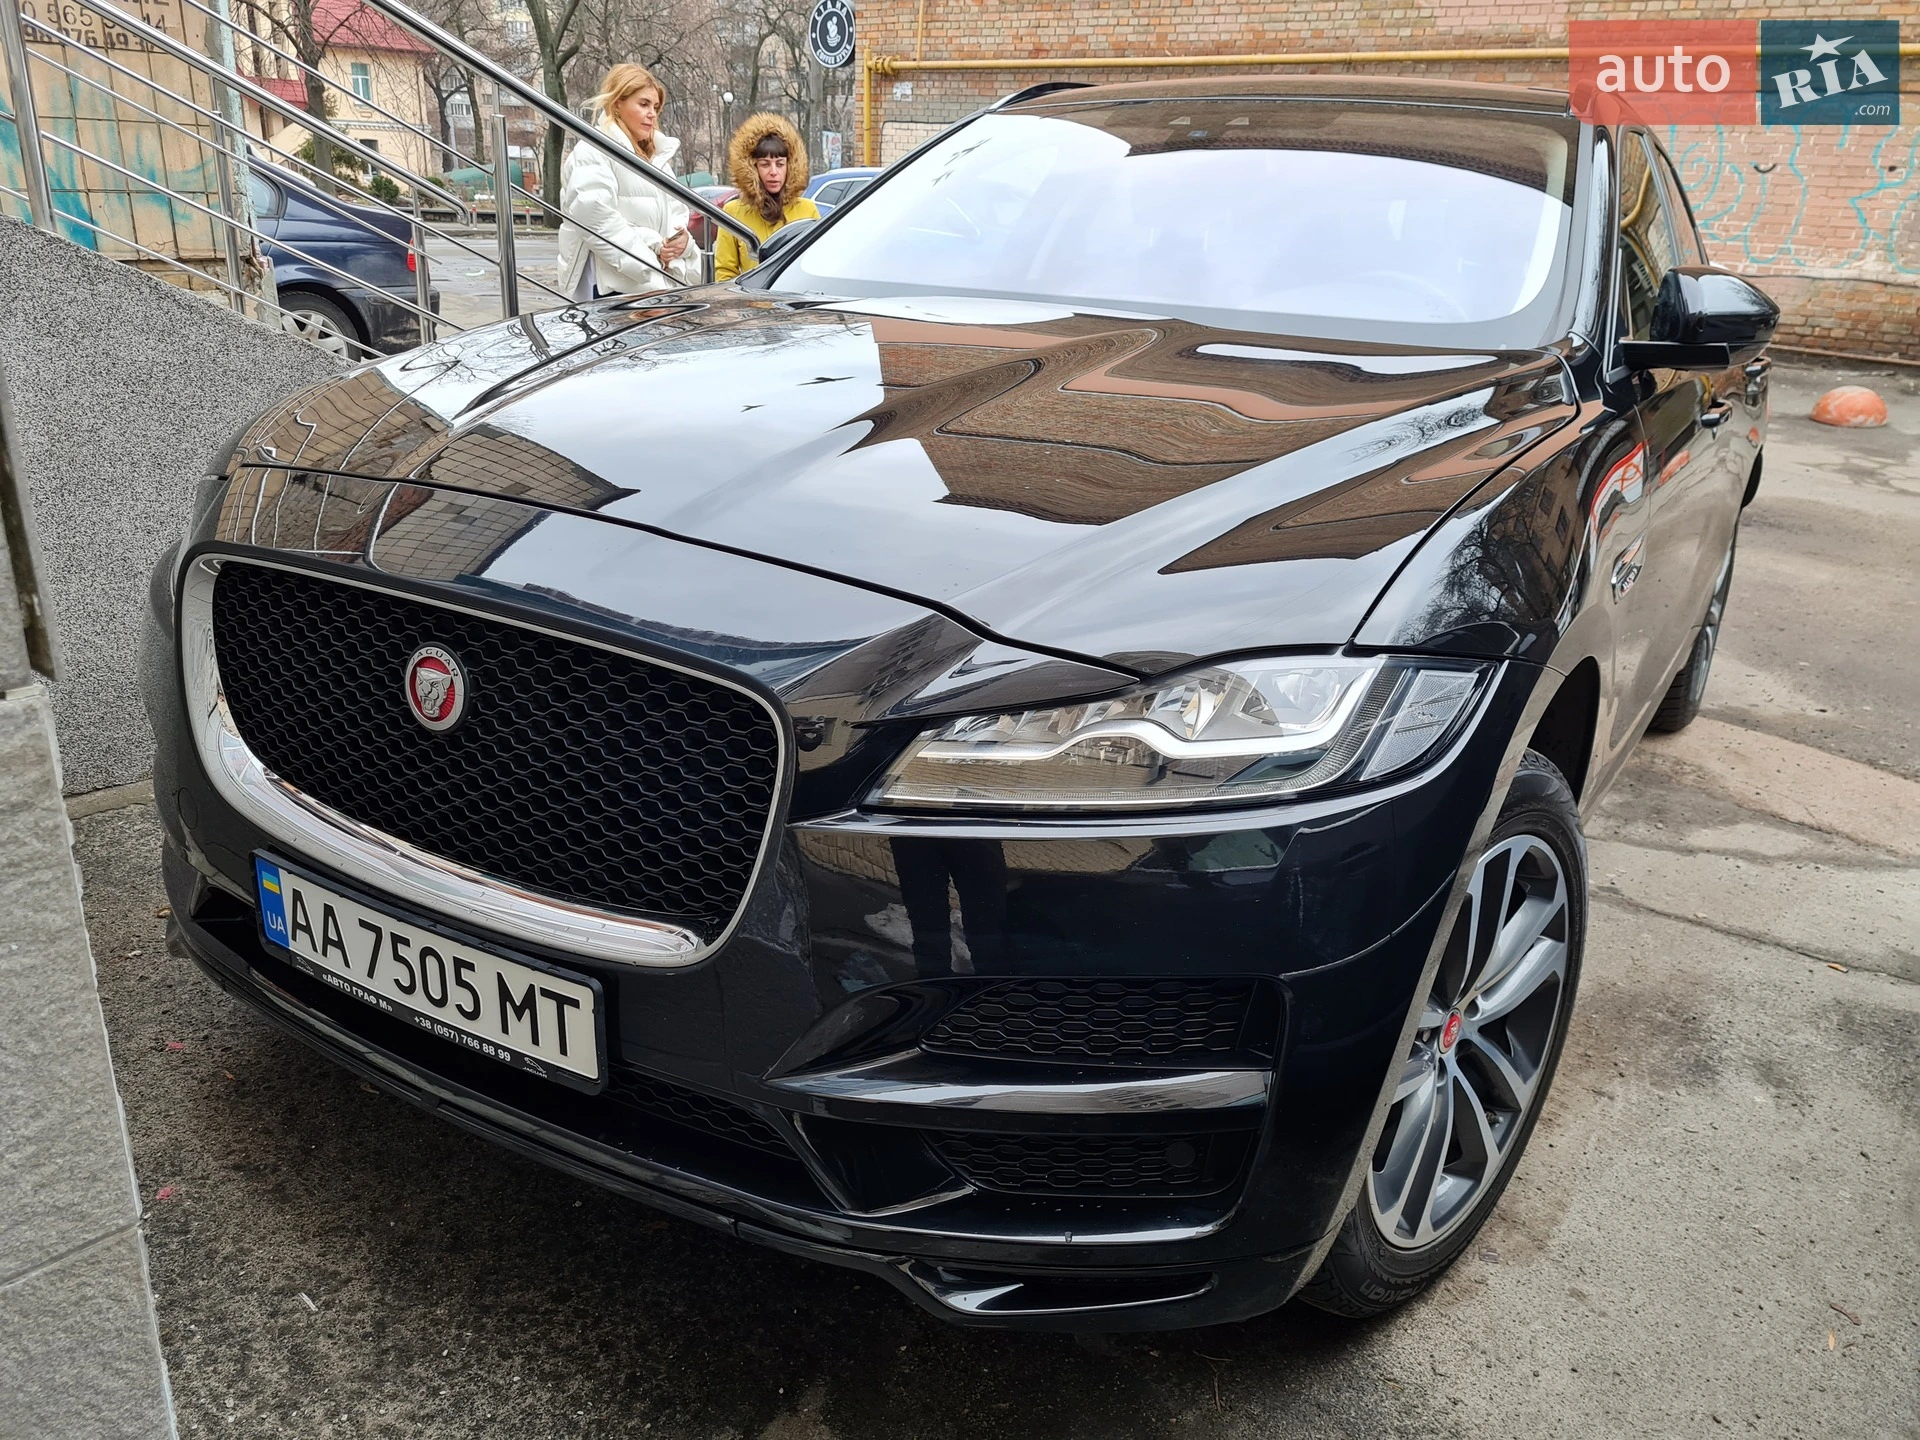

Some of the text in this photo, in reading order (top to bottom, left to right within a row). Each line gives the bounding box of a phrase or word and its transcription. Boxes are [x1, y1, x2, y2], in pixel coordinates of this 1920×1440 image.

[411, 648, 459, 677] JAGUAR
[267, 910, 286, 935] UA
[291, 887, 581, 1057] AA 7505 MT
[352, 987, 378, 1004] ГРАФ
[414, 1016, 511, 1062] +38 (057) 766 88 99
[522, 1066, 548, 1079] JAGUAR
